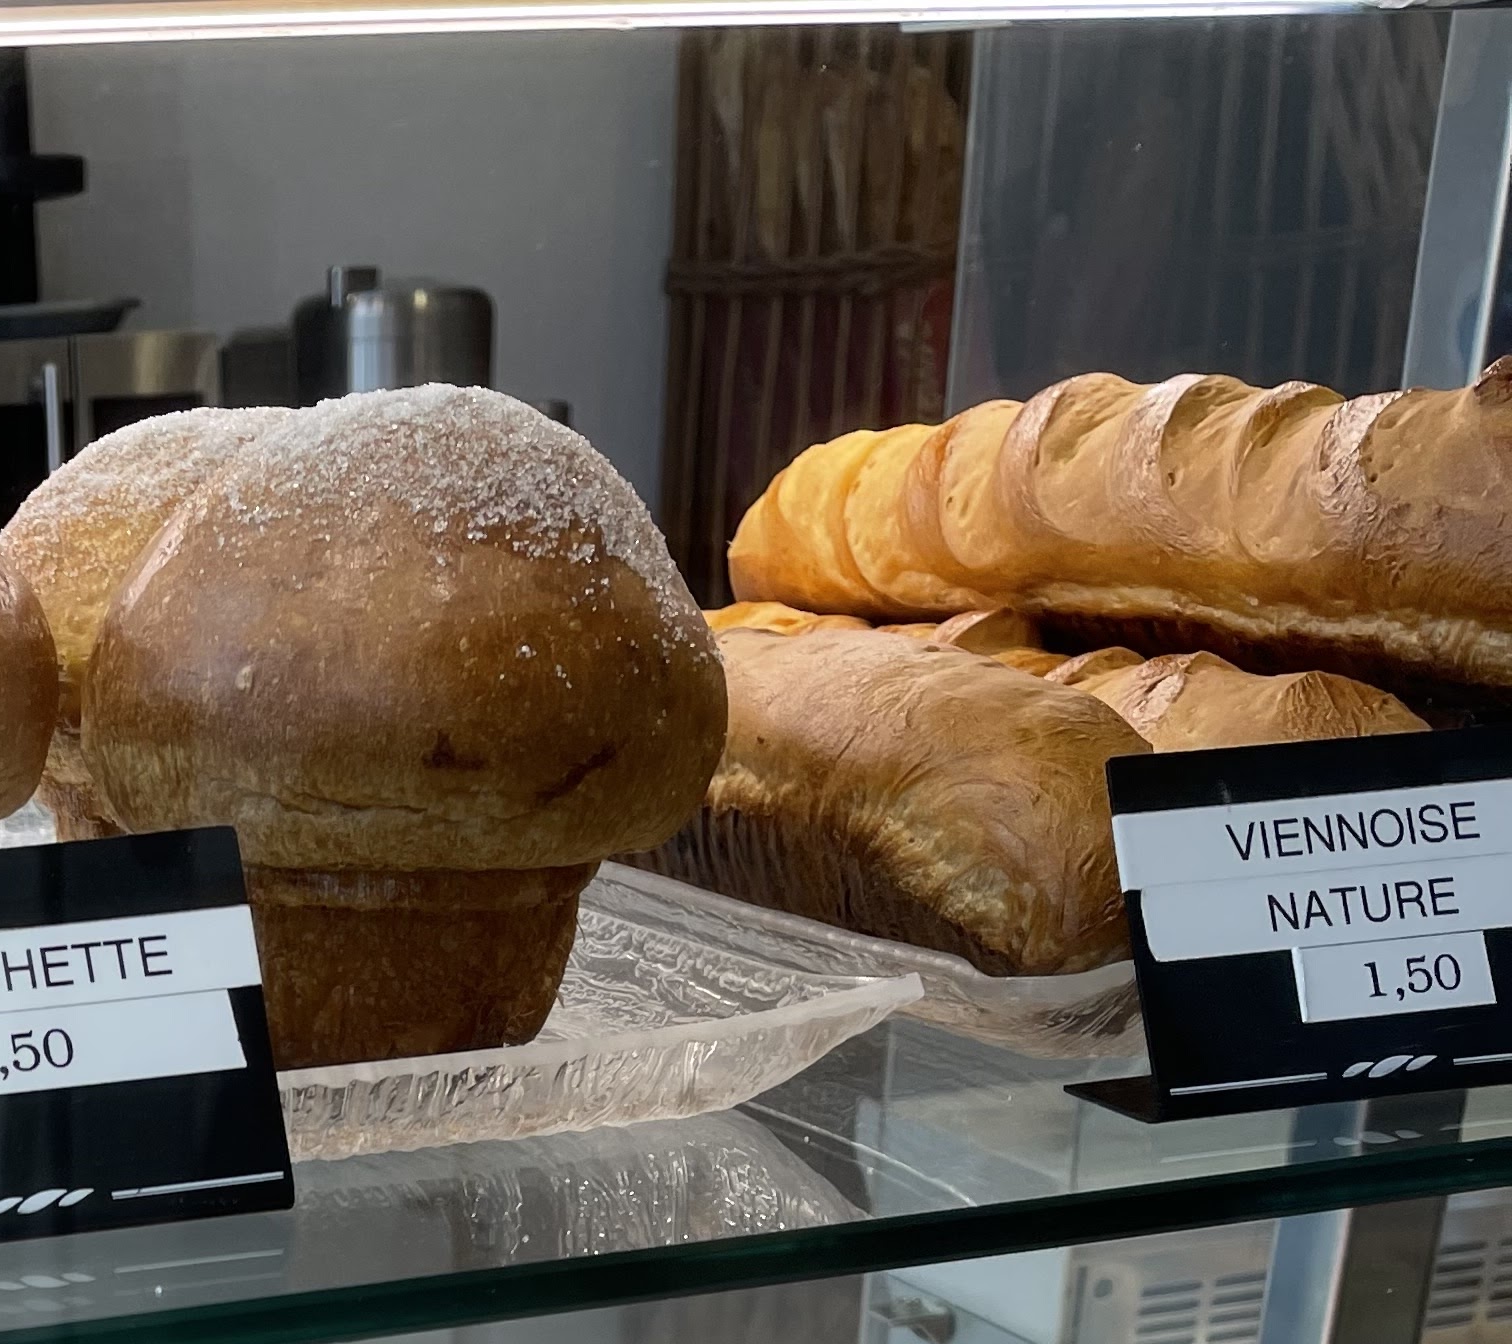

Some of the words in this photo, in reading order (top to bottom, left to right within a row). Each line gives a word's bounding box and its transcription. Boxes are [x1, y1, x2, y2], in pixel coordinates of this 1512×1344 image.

[1225, 801, 1481, 861] VIENNOISE
[1266, 876, 1460, 932] NATURE
[1363, 953, 1462, 1001] 1,50
